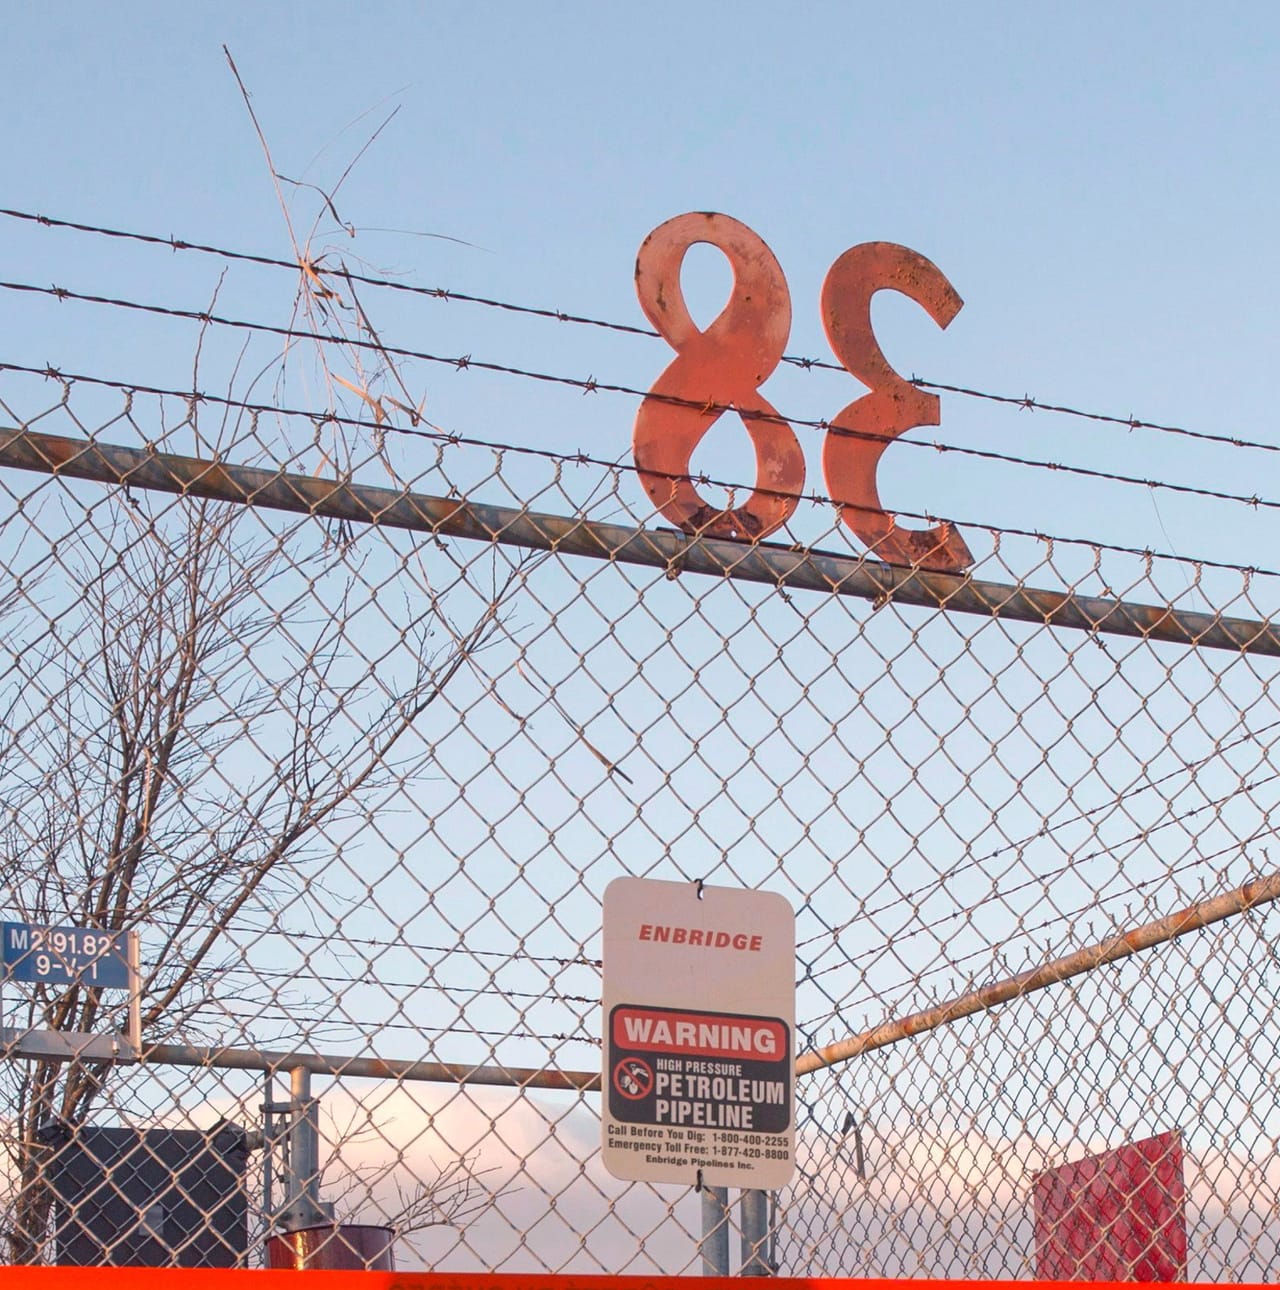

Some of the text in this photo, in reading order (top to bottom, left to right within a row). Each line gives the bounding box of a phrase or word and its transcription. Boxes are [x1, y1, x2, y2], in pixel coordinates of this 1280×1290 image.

[639, 924, 763, 951] ENBRIDGE
[623, 1016, 776, 1054] WARNING
[656, 1058, 742, 1077] HIGH PRESSURE
[655, 1073, 784, 1105] PETROLEUM
[655, 1100, 753, 1129] PIPELINE
[607, 1124, 789, 1147] Call Before You Dig: 1-800-400-2255
[608, 1137, 789, 1160] Emergency Toll Free: 1-877-420-8800
[646, 1154, 755, 1170] Enbridge Pipelines Inc.
